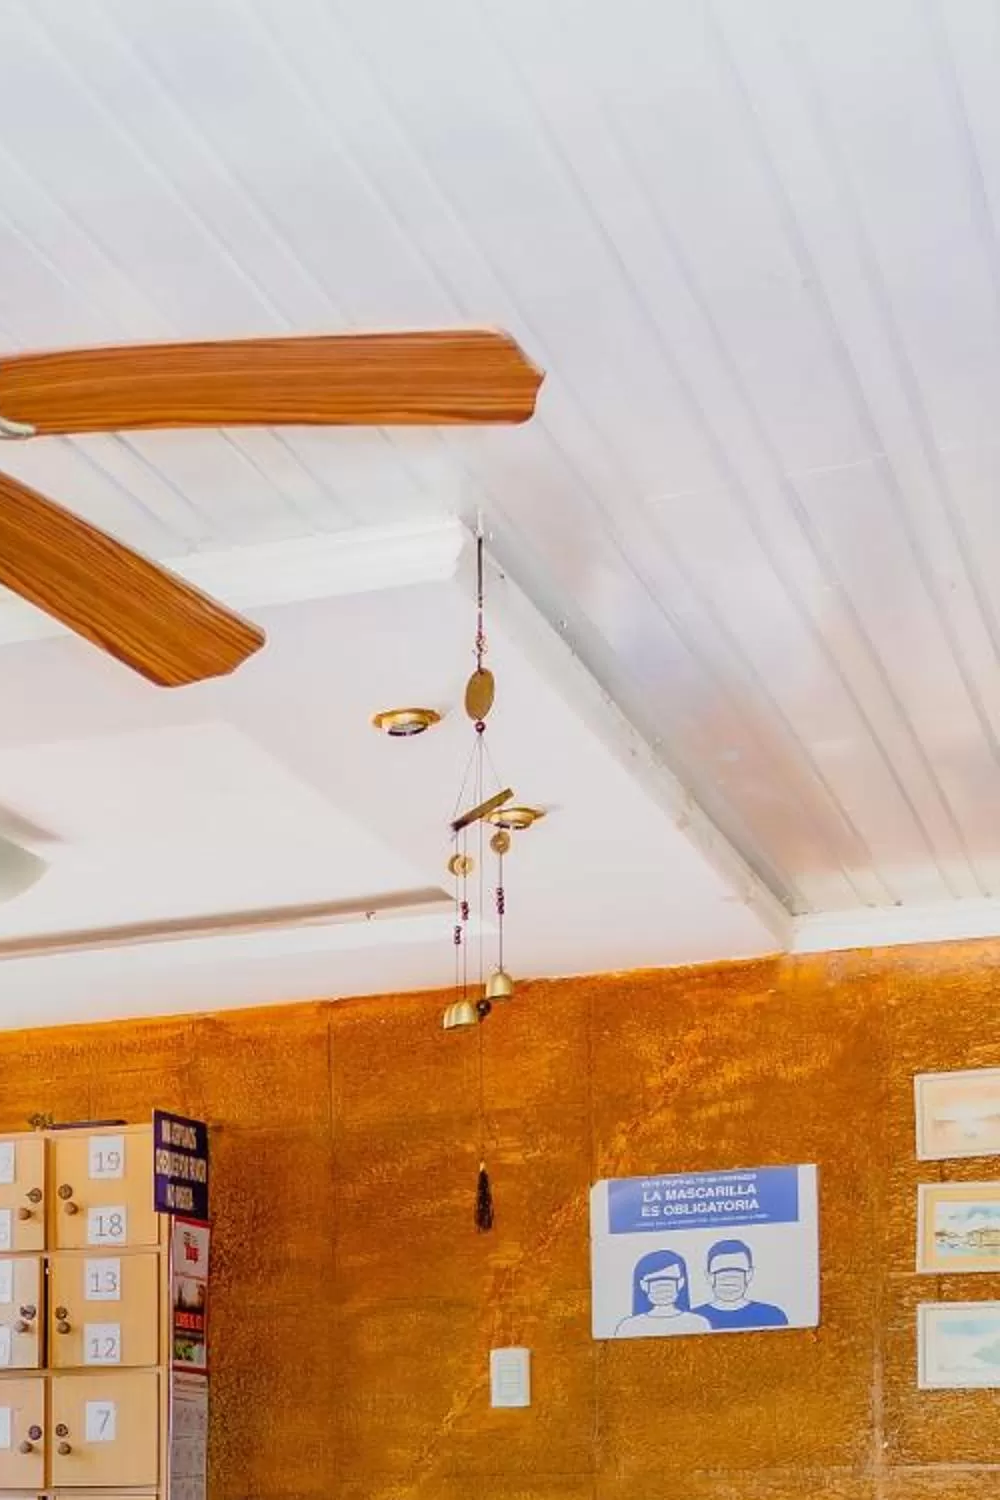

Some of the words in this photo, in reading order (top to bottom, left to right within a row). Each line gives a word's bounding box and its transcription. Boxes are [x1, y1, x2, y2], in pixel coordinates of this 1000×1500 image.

[92, 1150, 121, 1173] 19
[643, 1191, 662, 1203] LA
[665, 1183, 757, 1200] MASCARILLA
[641, 1205, 660, 1217] ES
[663, 1199, 760, 1216] OBLIGATORIA
[94, 1212, 123, 1238] 18
[89, 1270, 118, 1293] 13
[91, 1336, 117, 1359] 12
[96, 1408, 111, 1436] 7
